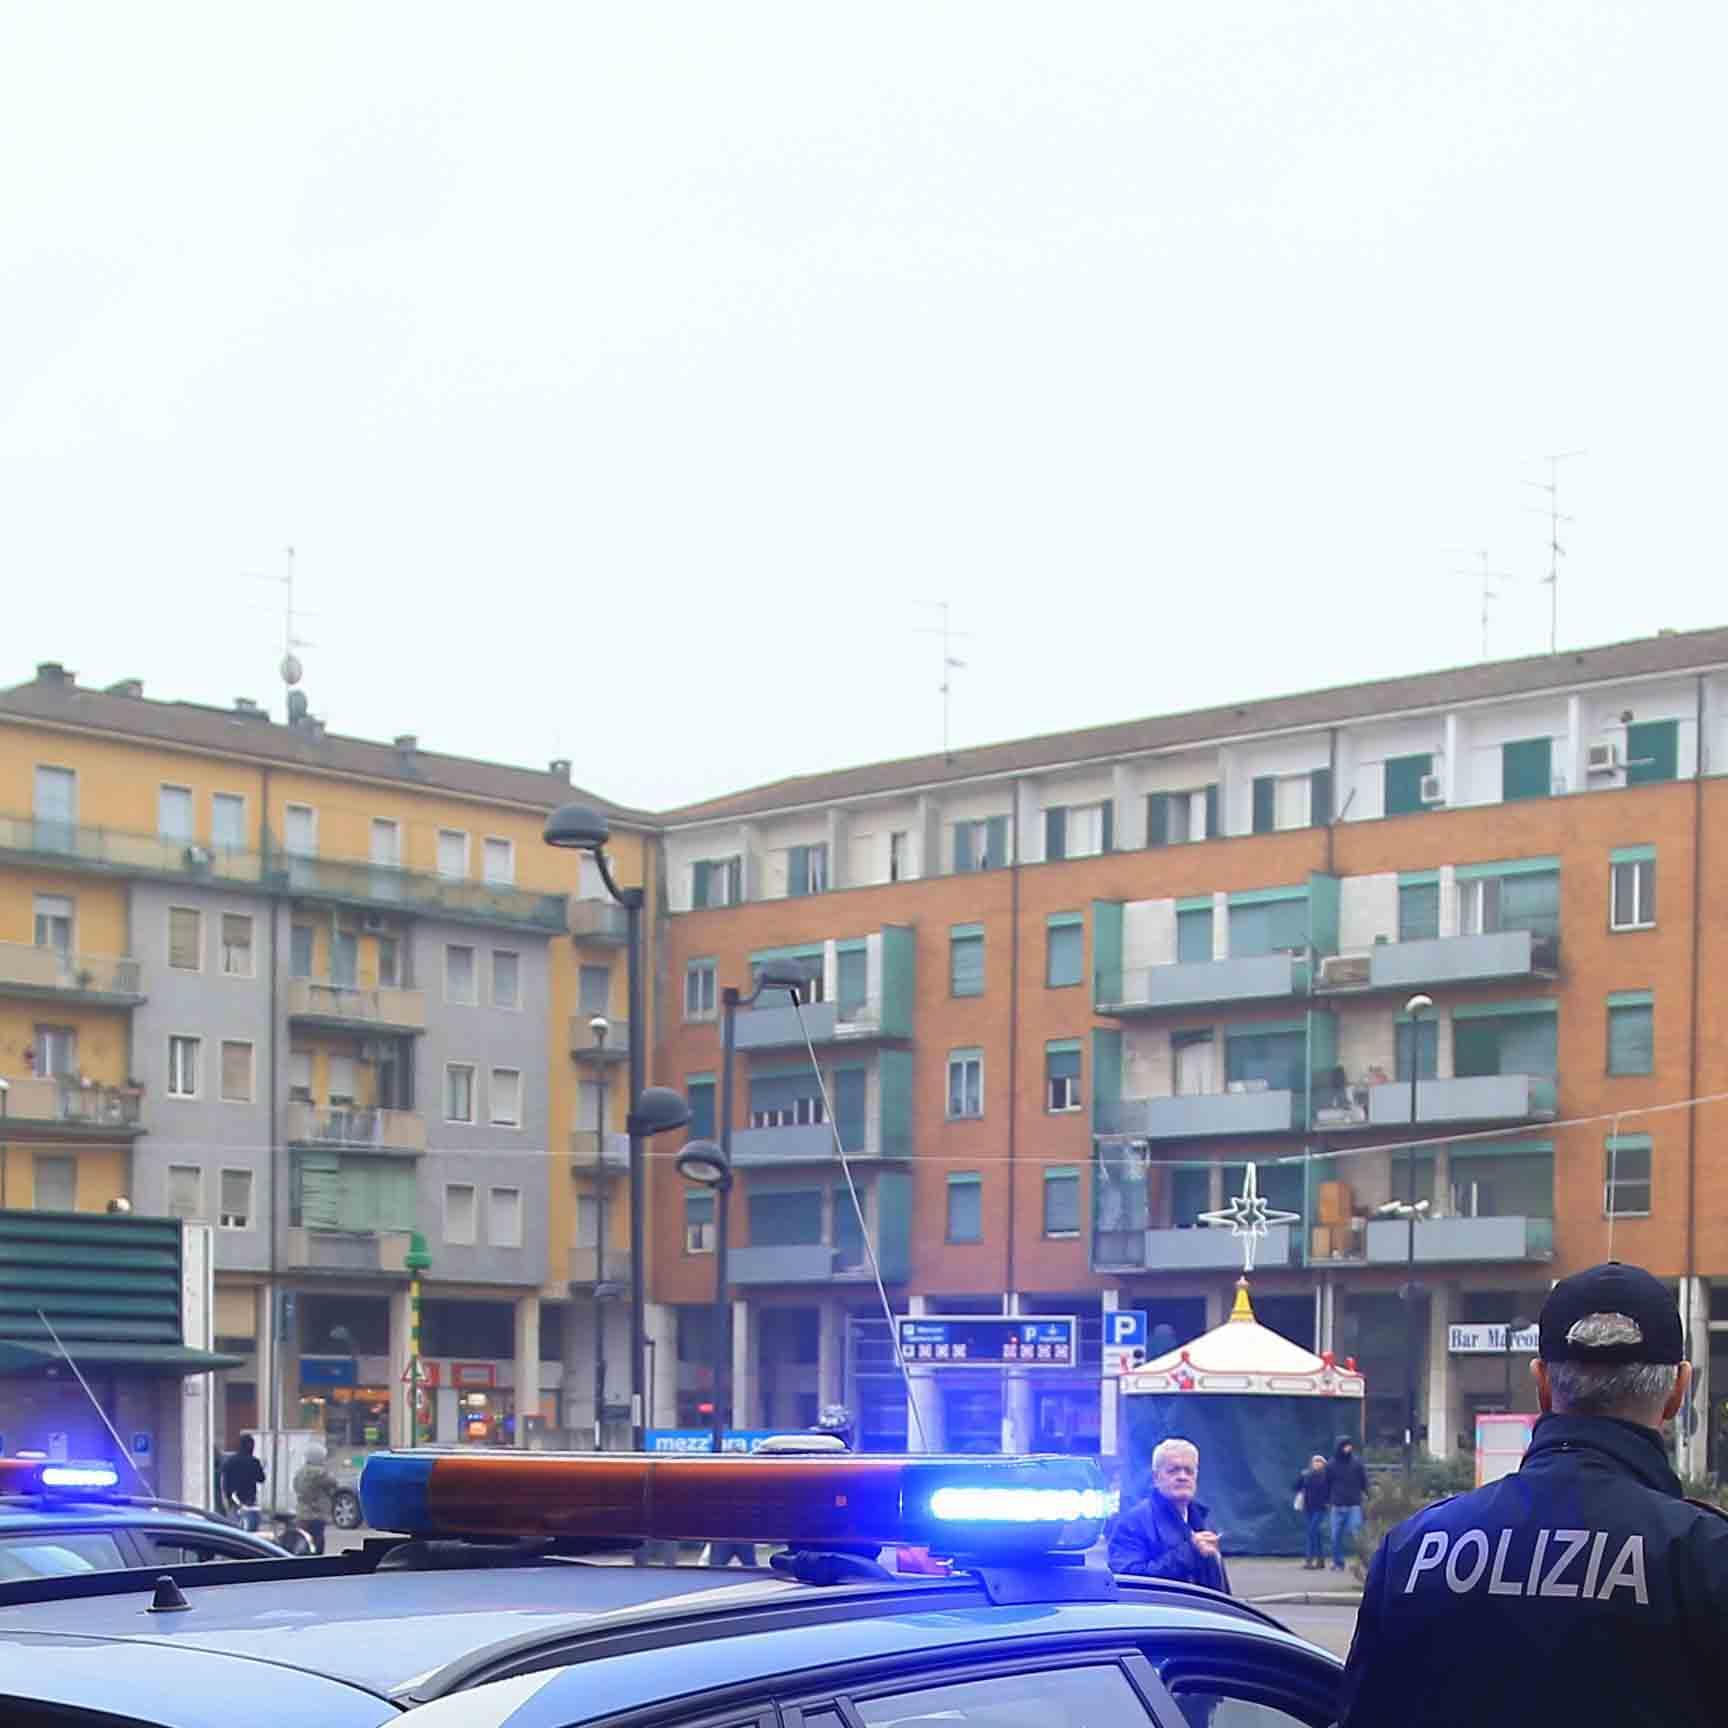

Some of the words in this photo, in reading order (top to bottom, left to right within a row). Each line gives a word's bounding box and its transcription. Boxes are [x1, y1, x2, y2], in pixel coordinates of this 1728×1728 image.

[1113, 1315, 1137, 1344] P
[1452, 1328, 1479, 1348] Bar
[1404, 1528, 1649, 1605] POLIZIA
